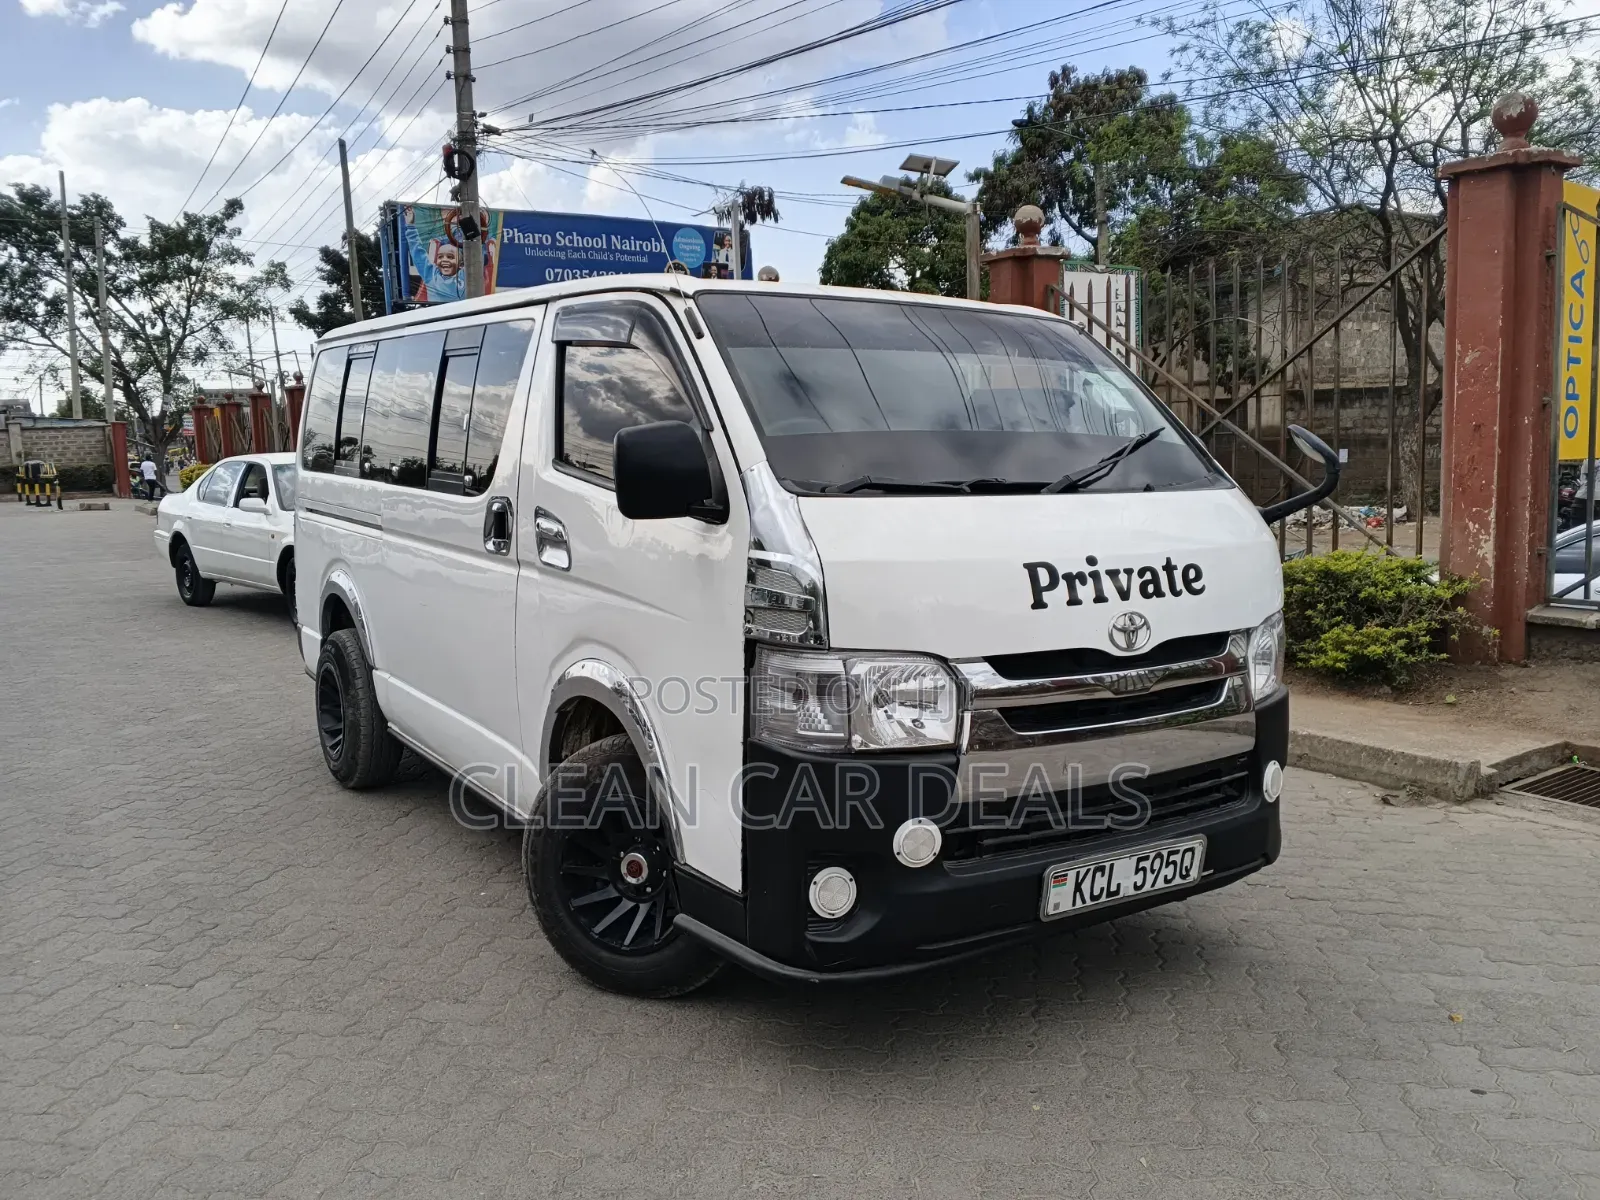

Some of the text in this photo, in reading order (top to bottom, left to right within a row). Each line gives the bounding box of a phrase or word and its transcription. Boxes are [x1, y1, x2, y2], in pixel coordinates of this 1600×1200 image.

[503, 228, 666, 253] Pharo School Nairobi
[525, 247, 649, 263] Unlocking Each Child's Potential
[1563, 268, 1586, 439] OPTICA
[1023, 554, 1207, 610] Private
[1072, 846, 1196, 907] KCL 595Q
